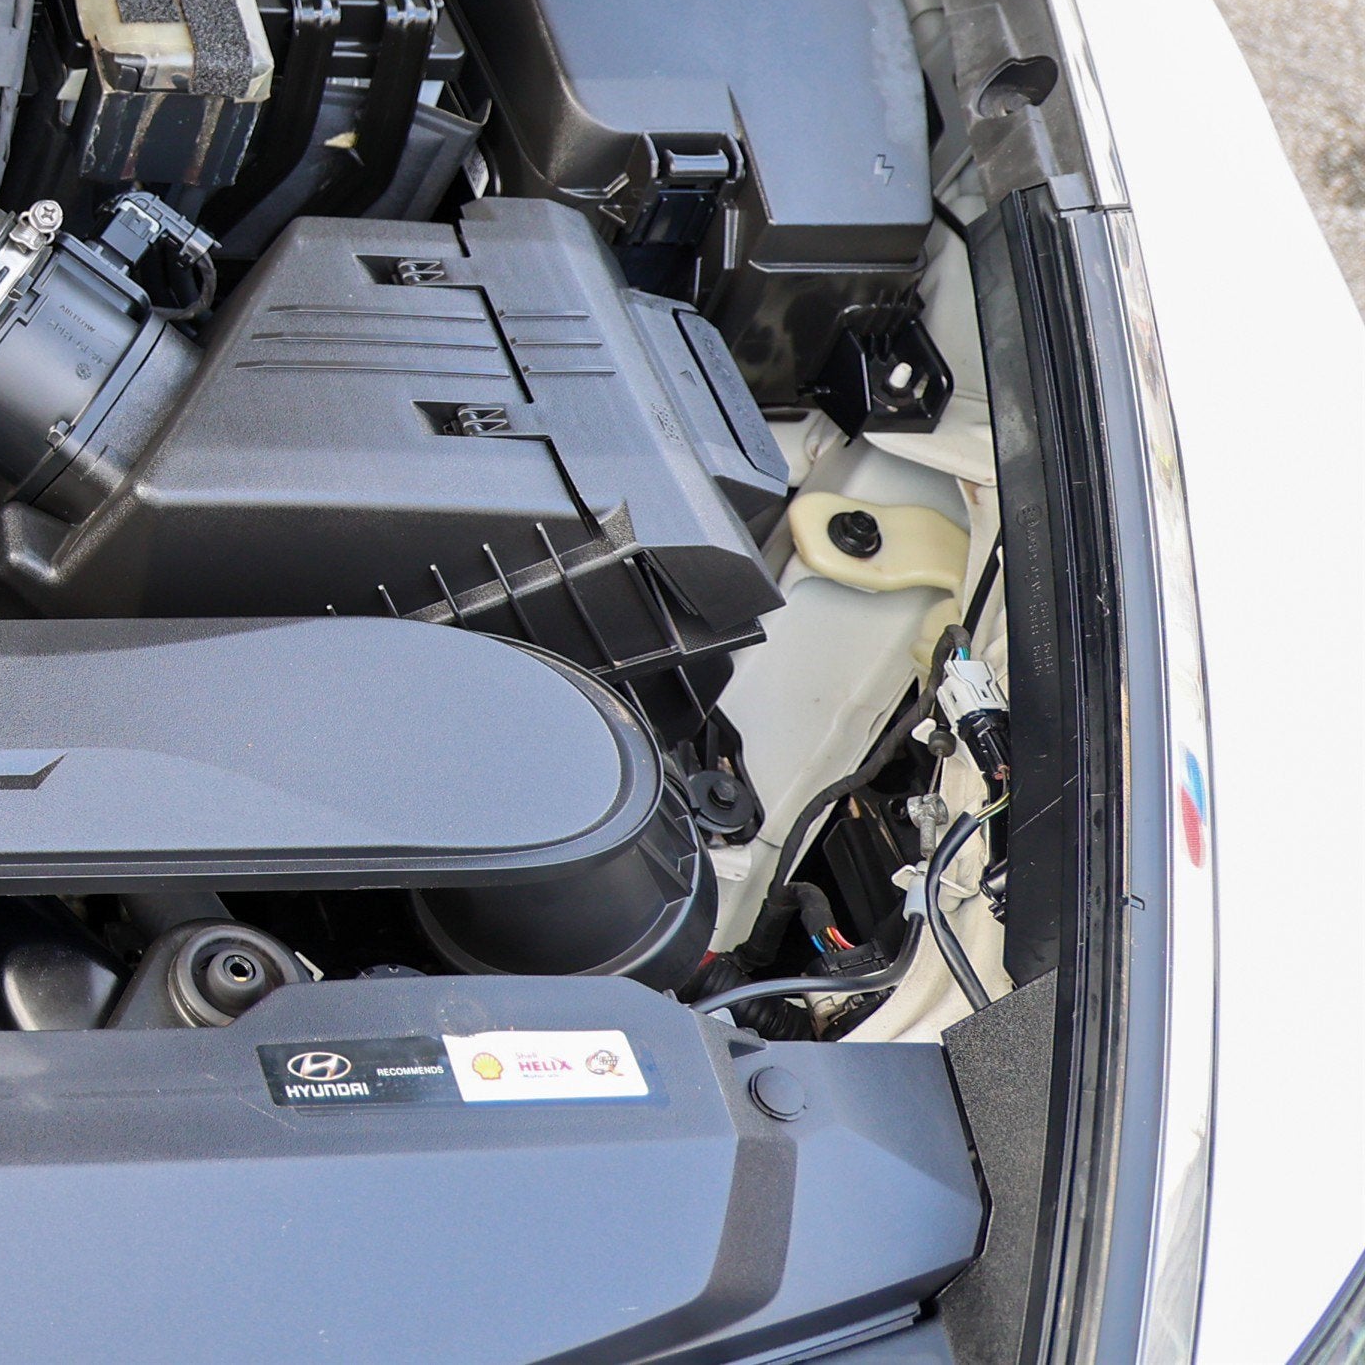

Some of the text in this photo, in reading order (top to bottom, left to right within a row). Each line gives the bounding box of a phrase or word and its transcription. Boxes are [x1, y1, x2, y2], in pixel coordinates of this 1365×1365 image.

[518, 1061, 572, 1071] HELIX
[285, 1065, 444, 1098] HYUNDAI RECOMMENDS
